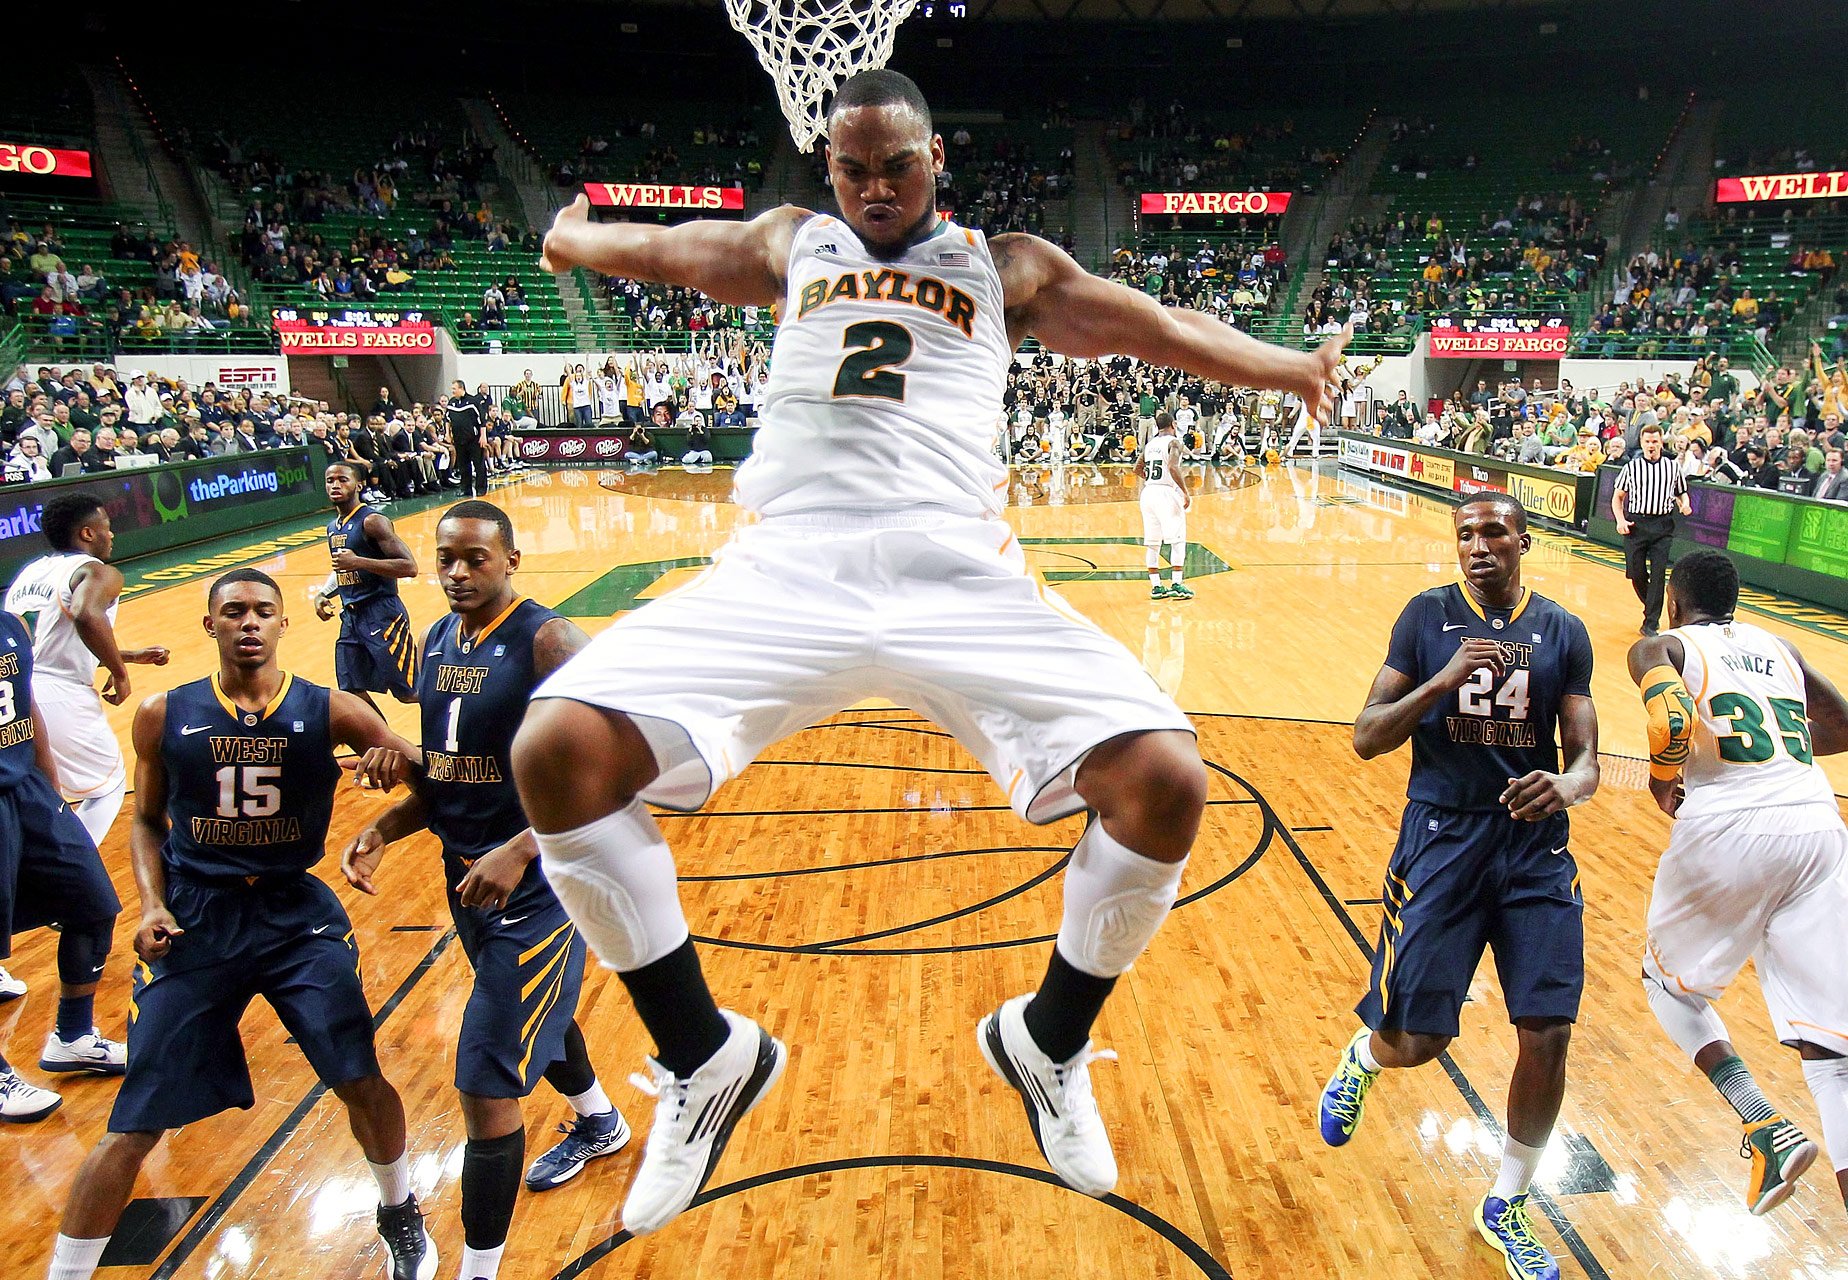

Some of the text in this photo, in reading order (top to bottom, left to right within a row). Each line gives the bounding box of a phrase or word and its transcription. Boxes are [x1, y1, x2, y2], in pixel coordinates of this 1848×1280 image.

[950, 4, 966, 18] 47
[603, 184, 723, 209] WELLS
[1739, 172, 1848, 201] WELL
[1163, 192, 1269, 214] FARGO
[312, 311, 328, 321] BU
[374, 312, 399, 321] WVU
[407, 312, 422, 322] 47
[798, 268, 977, 340] BAYLOR
[1517, 319, 1540, 328] WVU
[1546, 318, 1563, 328] 47
[280, 331, 433, 348] WELLS FARGO
[1433, 337, 1499, 352] WELLS
[219, 367, 276, 383] ESPN
[831, 320, 914, 403] 2
[4, 471, 25, 482] POSS
[1471, 465, 1489, 482] Waco
[1510, 476, 1569, 513] Miller KIA
[12, 583, 55, 605] FRANKLIN
[1460, 636, 1533, 667] ST
[436, 664, 490, 694] WEST
[1458, 665, 1531, 720] 24
[445, 697, 463, 753] 1
[1446, 716, 1536, 748] VIRGINIA
[1708, 692, 1813, 767] 35
[209, 736, 288, 763] WEST
[215, 765, 282, 818] 15
[191, 816, 301, 846] VIRGINIA
